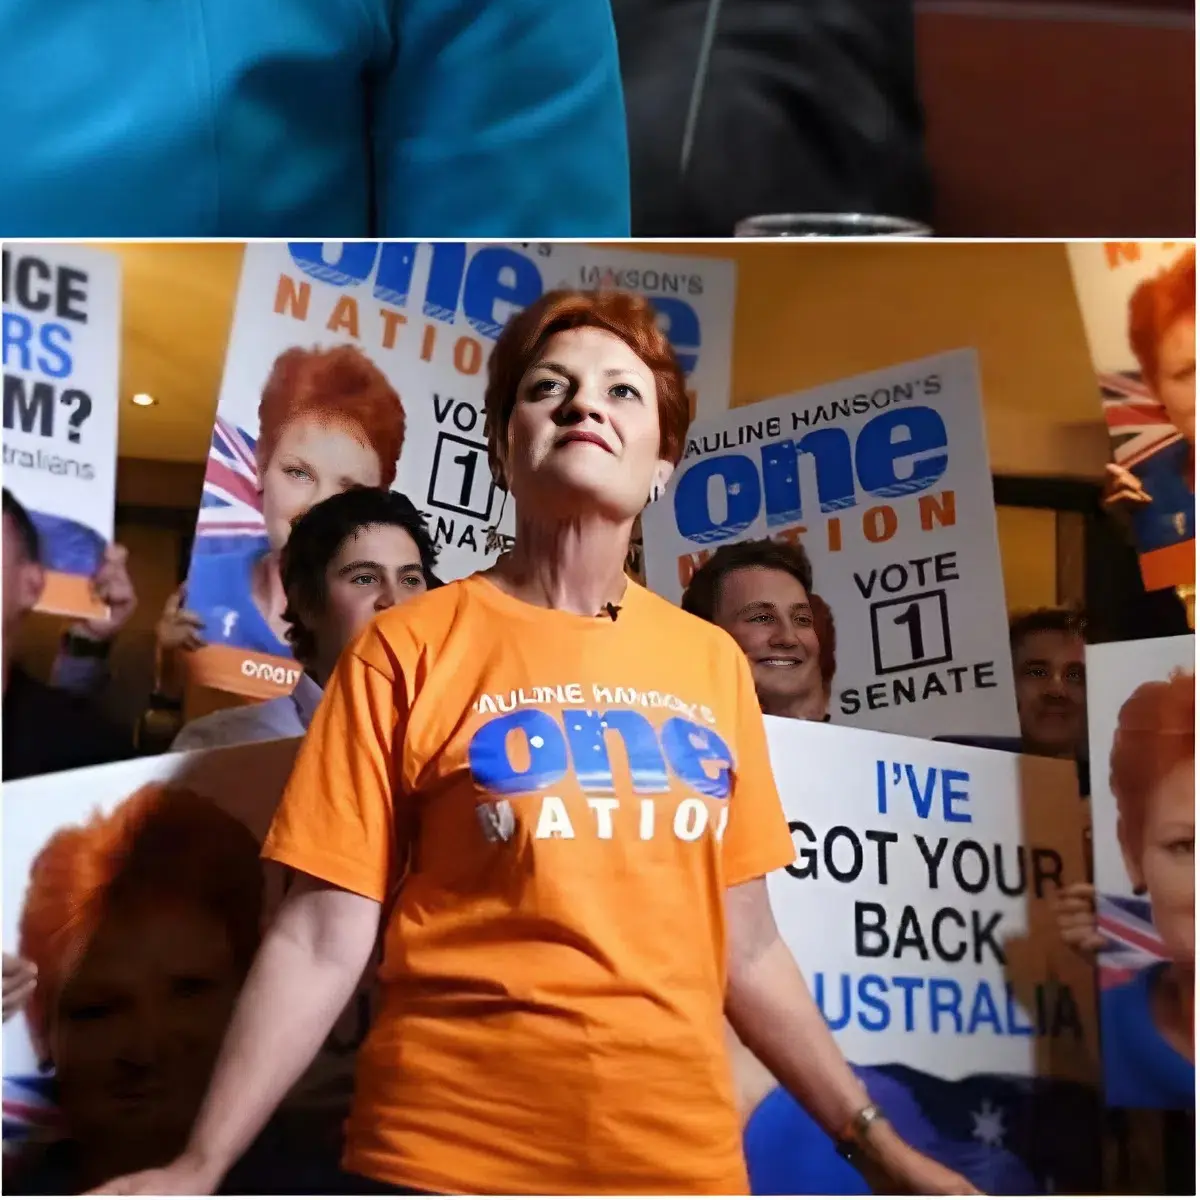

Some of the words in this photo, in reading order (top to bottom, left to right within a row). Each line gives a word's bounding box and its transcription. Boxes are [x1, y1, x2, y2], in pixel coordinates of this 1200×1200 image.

[2, 312, 73, 379] RS
[3, 374, 92, 444] M?
[433, 393, 487, 433] VO
[791, 374, 942, 431] HANSON'S
[454, 450, 478, 507] 1
[674, 405, 949, 545] one
[853, 552, 959, 599] VOTE
[893, 609, 925, 660] 1
[840, 661, 998, 715] SENATE
[468, 708, 736, 799] one
[876, 760, 972, 823] I'VE
[785, 820, 898, 885] GOT
[913, 833, 1064, 898] YOUR
[854, 900, 1007, 965] BACK
